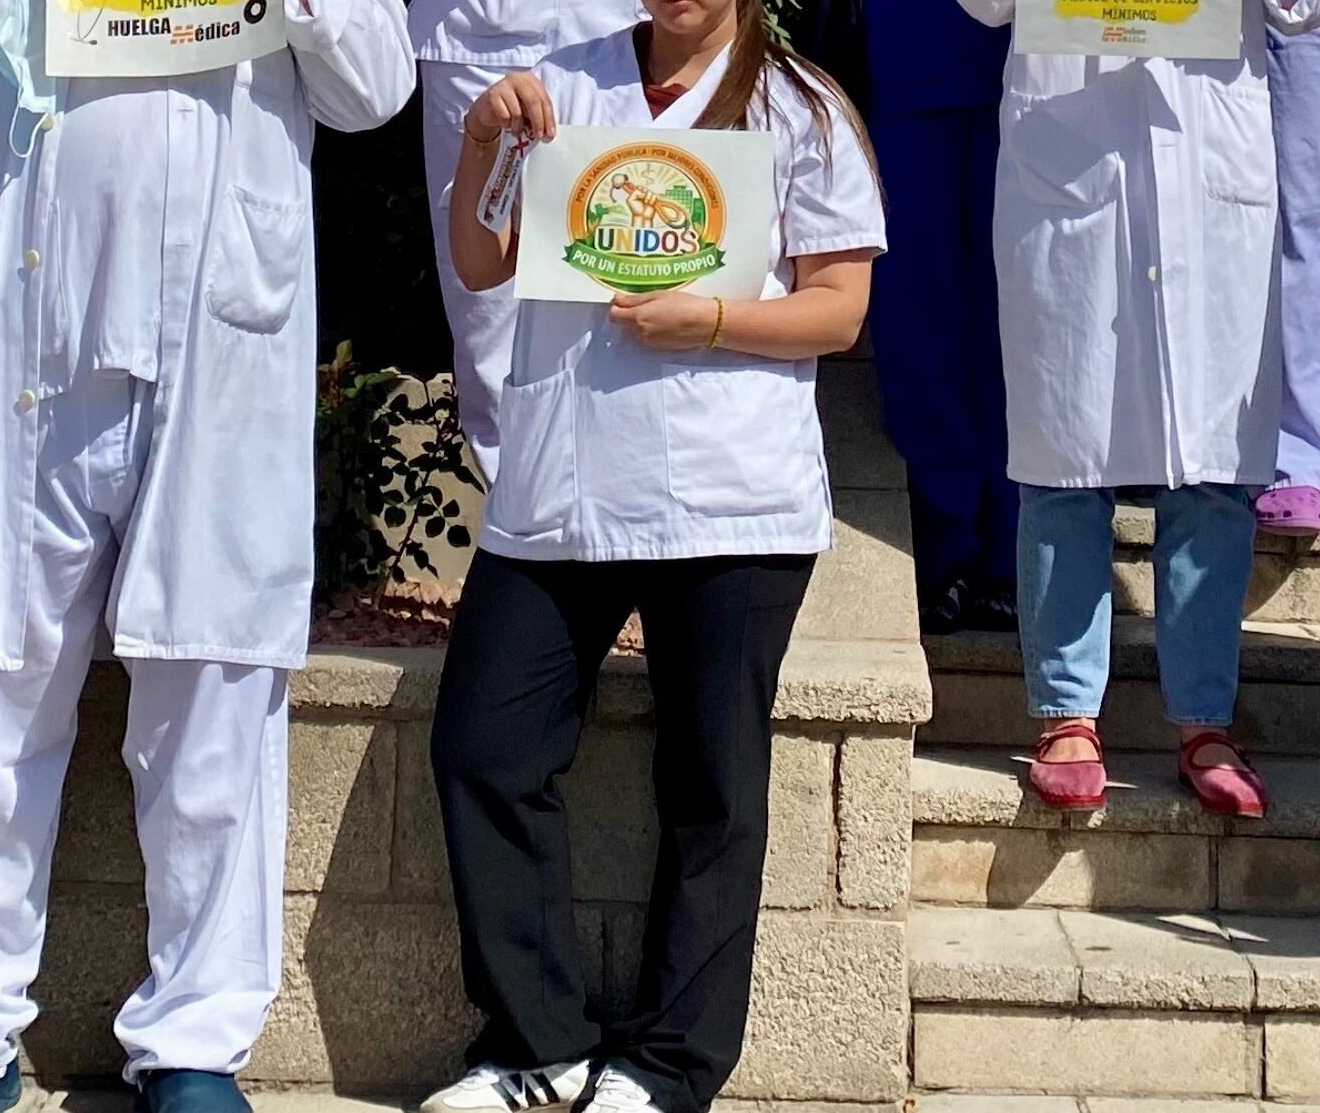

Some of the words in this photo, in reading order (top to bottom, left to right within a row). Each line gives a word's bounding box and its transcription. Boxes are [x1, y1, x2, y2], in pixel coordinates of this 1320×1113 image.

[107, 17, 171, 37] HUELGA
[651, 149, 667, 157] POR
[598, 228, 699, 255] UNIDOS
[573, 250, 596, 268] POR
[598, 259, 616, 273] UN
[618, 262, 671, 276] ESTATUTO
[673, 254, 716, 275] PROPIO
